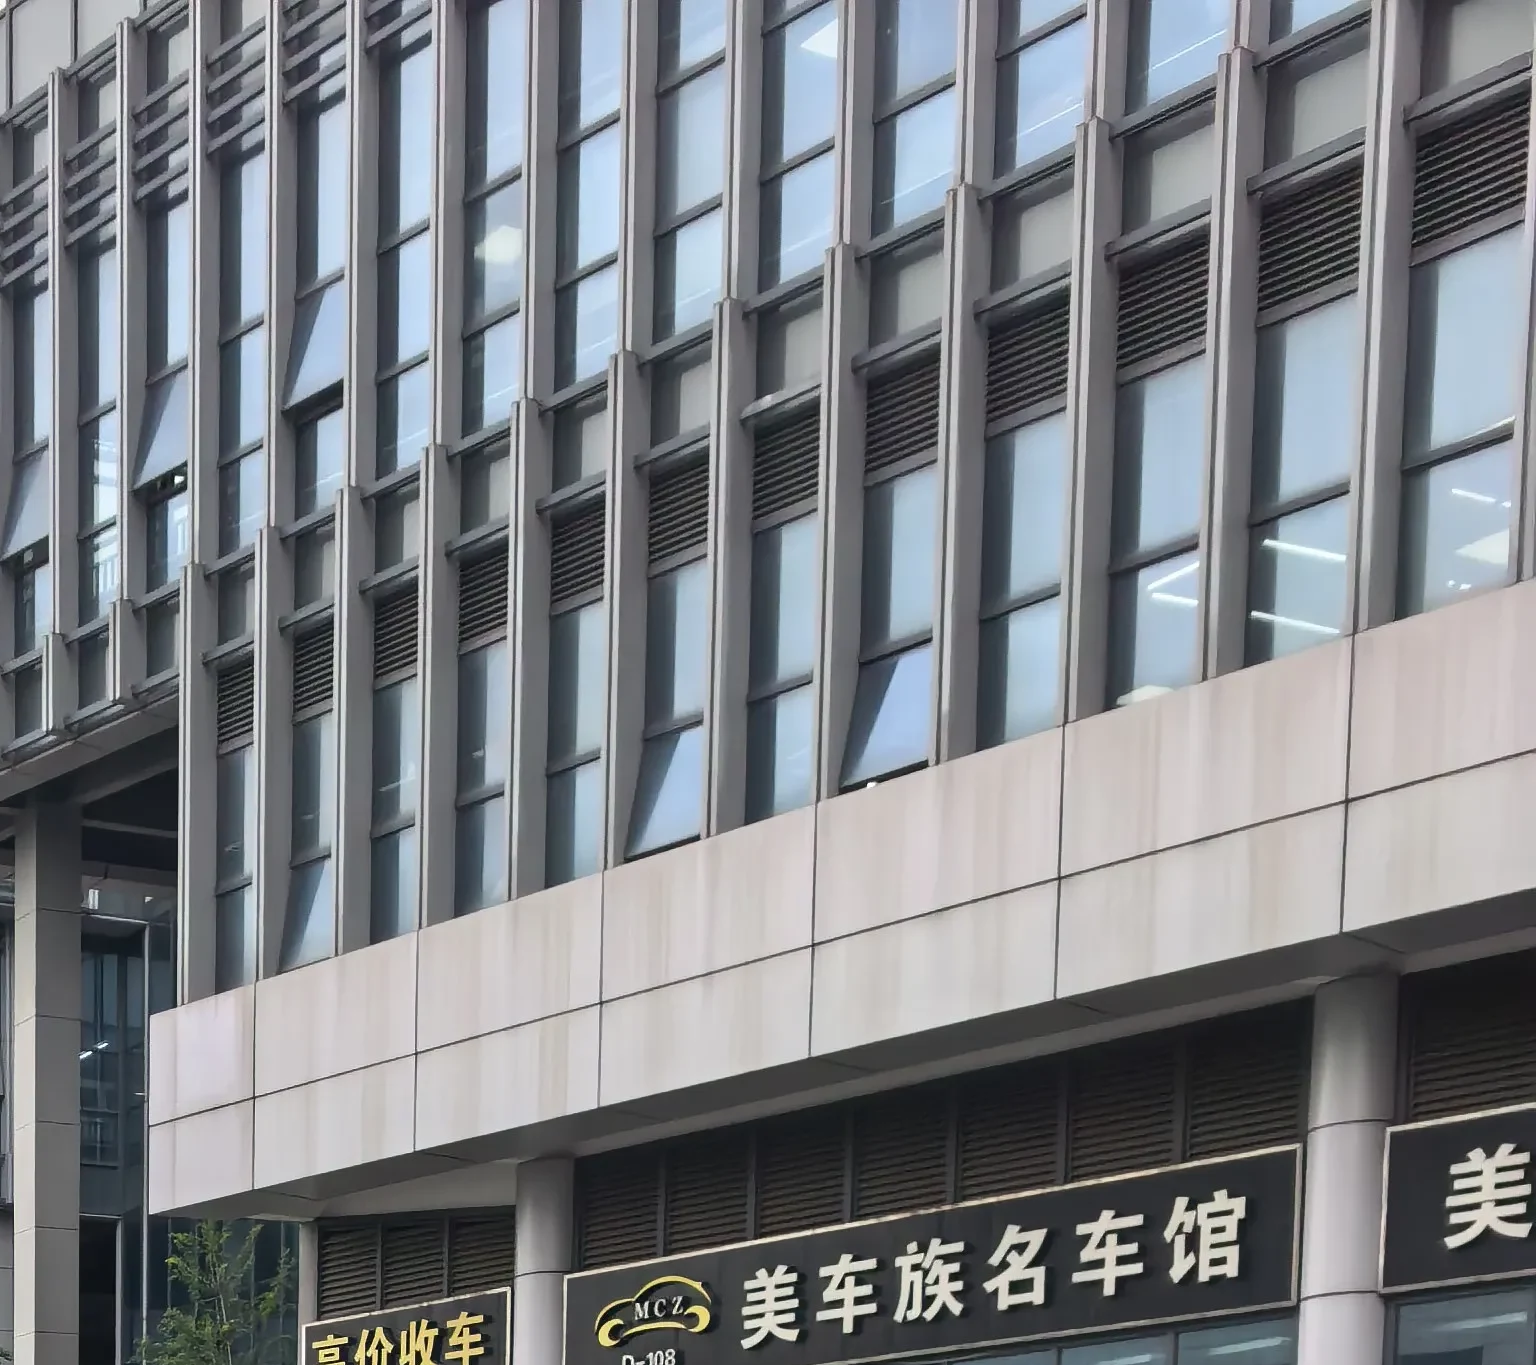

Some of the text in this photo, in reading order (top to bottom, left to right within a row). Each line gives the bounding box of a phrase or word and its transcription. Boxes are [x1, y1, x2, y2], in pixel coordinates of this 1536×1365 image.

[1444, 1143, 1533, 1249] 美
[634, 1295, 684, 1321] MCZ
[740, 1188, 1247, 1350] 美车族名车馆
